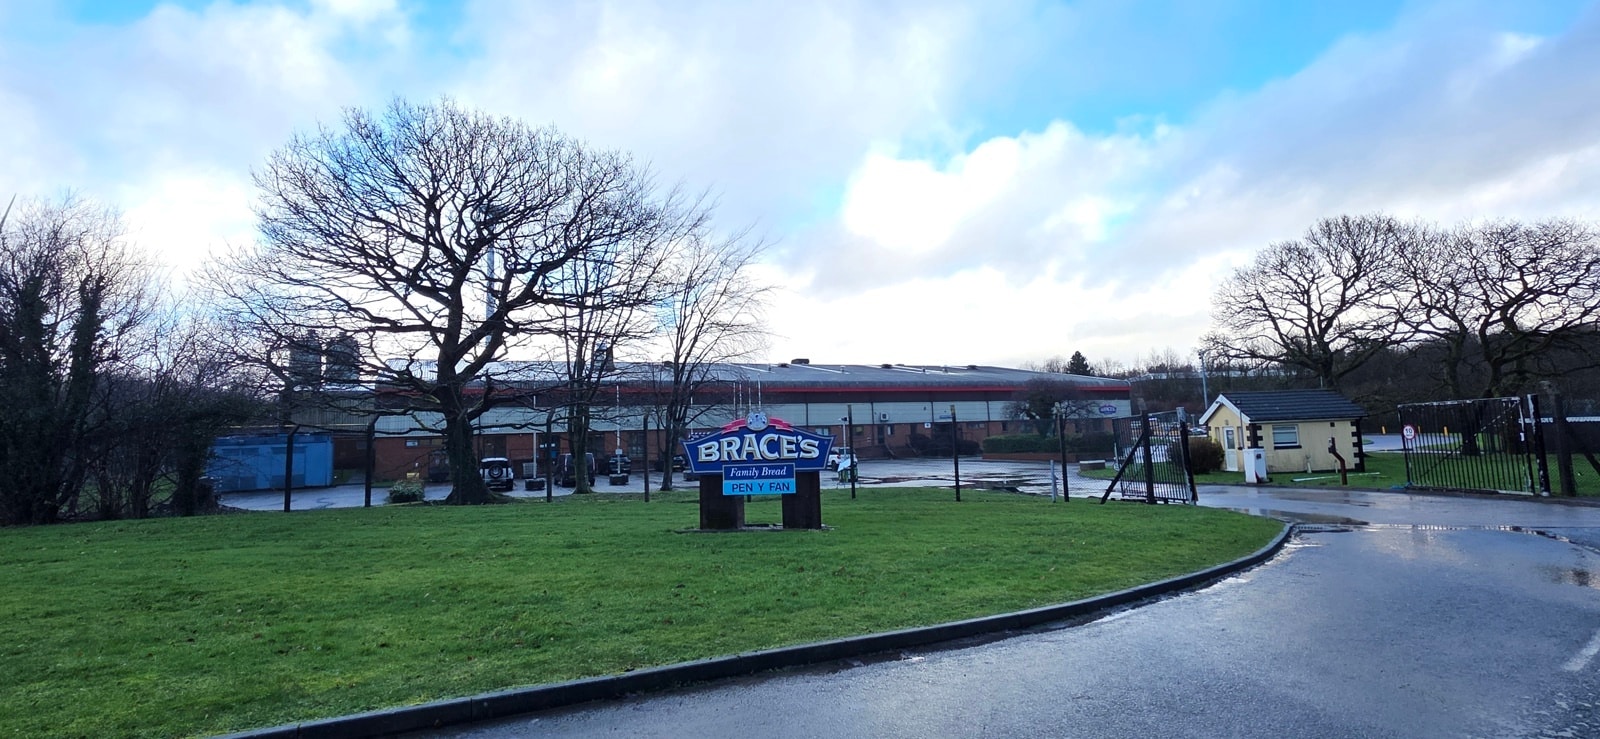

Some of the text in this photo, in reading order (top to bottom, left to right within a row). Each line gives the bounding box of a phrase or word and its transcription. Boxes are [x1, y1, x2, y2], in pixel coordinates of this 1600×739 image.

[698, 433, 820, 462] BRACE'S
[730, 467, 787, 478] Family Bread
[731, 482, 790, 493] PEN Y FAN
